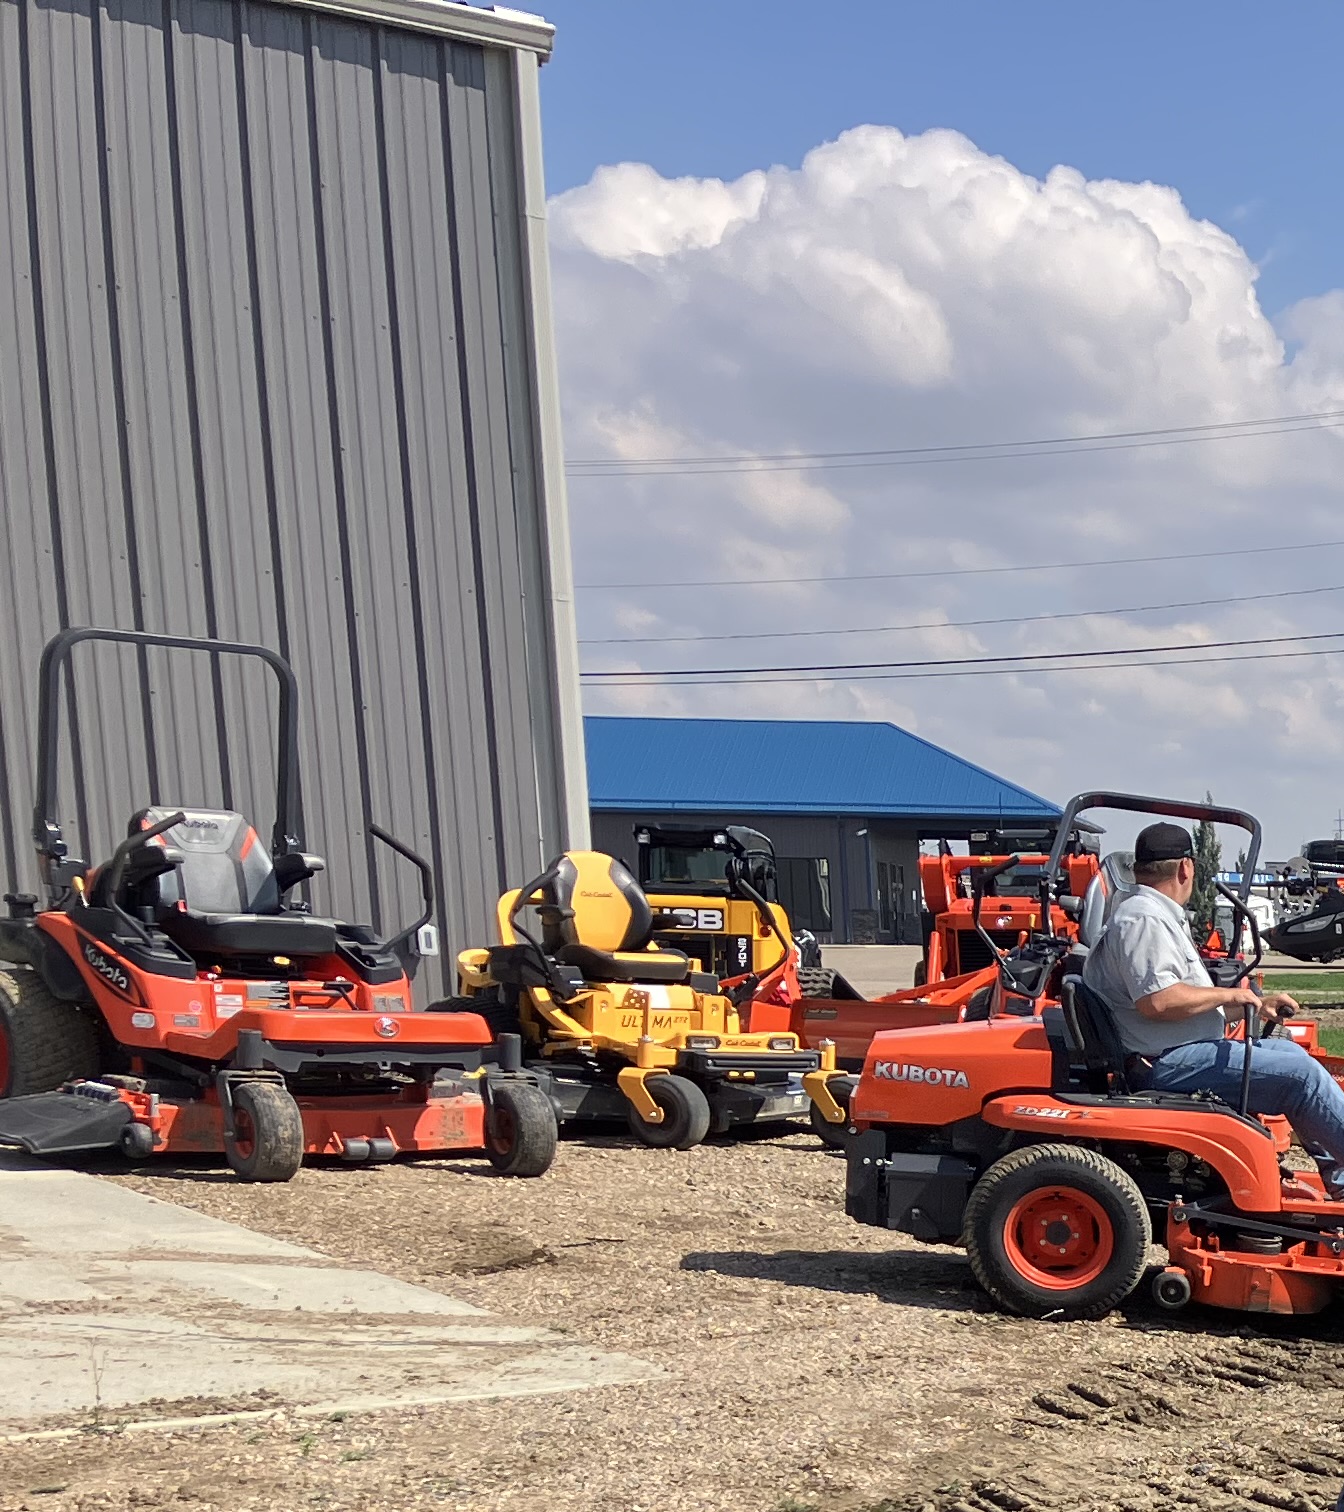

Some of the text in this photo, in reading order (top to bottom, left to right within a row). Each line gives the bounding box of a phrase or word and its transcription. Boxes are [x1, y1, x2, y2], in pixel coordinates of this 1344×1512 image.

[662, 907, 723, 930] CB
[84, 944, 128, 989] Kubota
[621, 1015, 672, 1028] ULMA
[874, 1061, 970, 1089] KUBOTA
